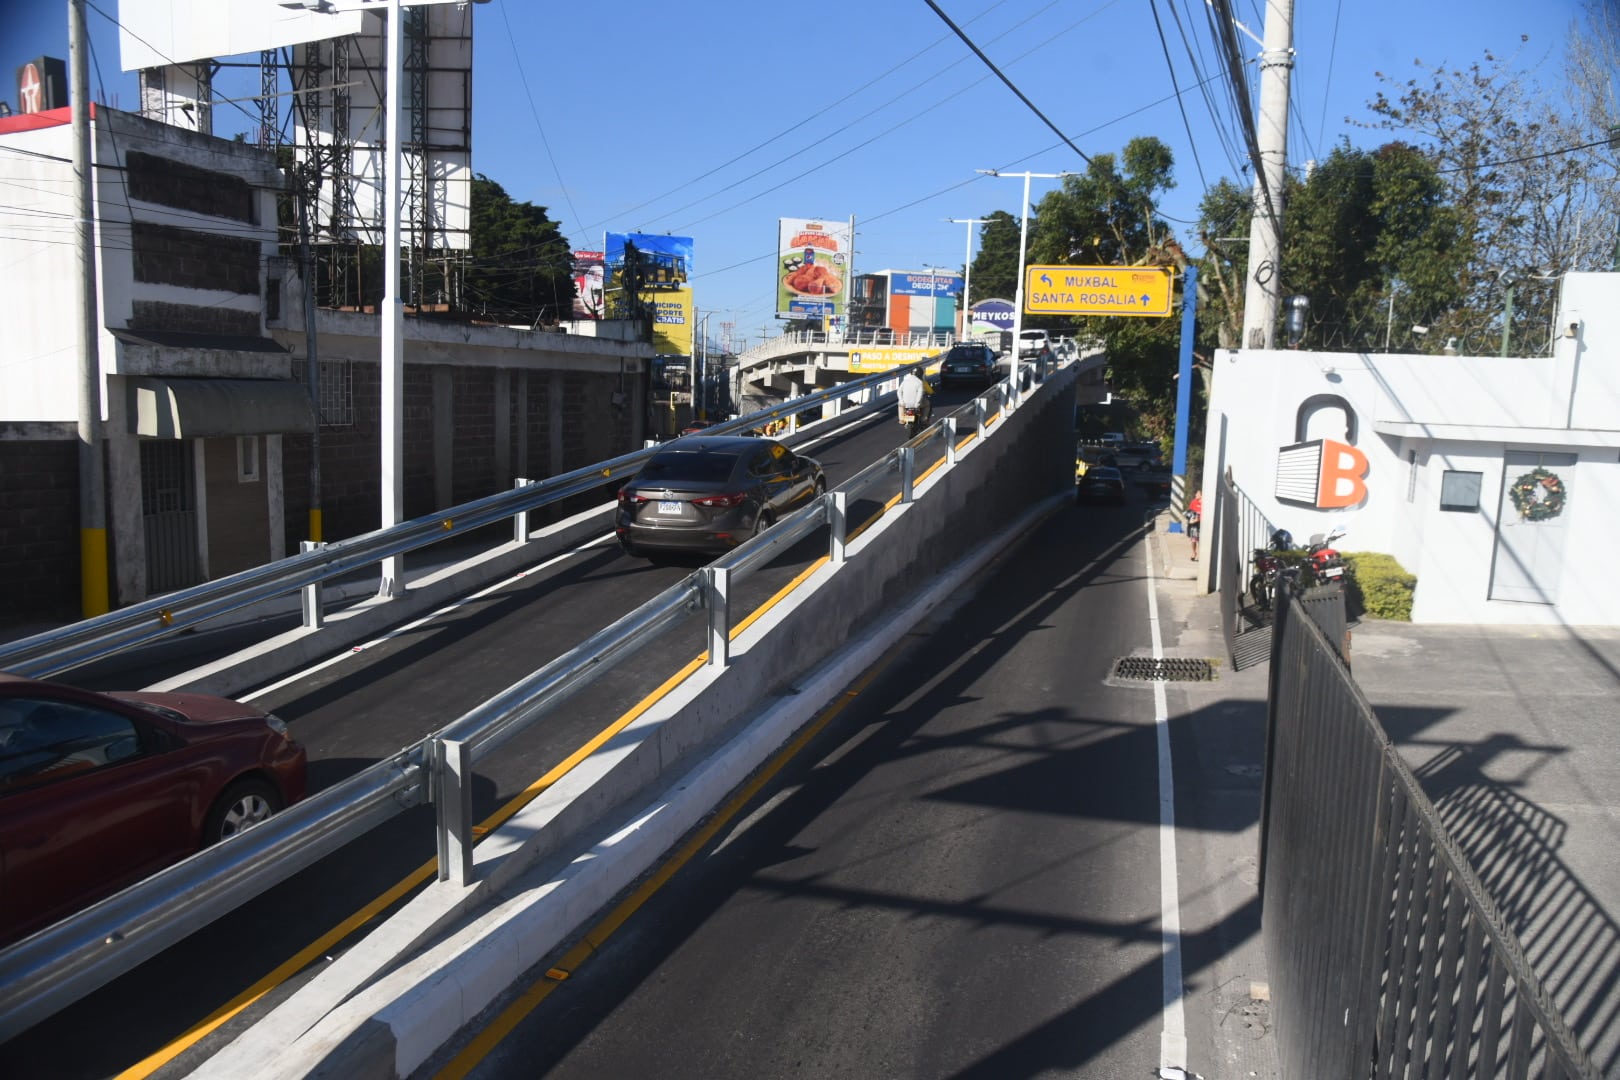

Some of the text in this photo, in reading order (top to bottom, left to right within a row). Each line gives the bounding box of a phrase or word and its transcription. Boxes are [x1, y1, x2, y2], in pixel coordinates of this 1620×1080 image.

[1065, 276, 1118, 288] MUXBAL
[1032, 292, 1136, 305] SANTA ROSALIA
[656, 316, 684, 324] GRATIS
[972, 311, 1015, 321] MEYKOS
[1316, 438, 1369, 509] B
